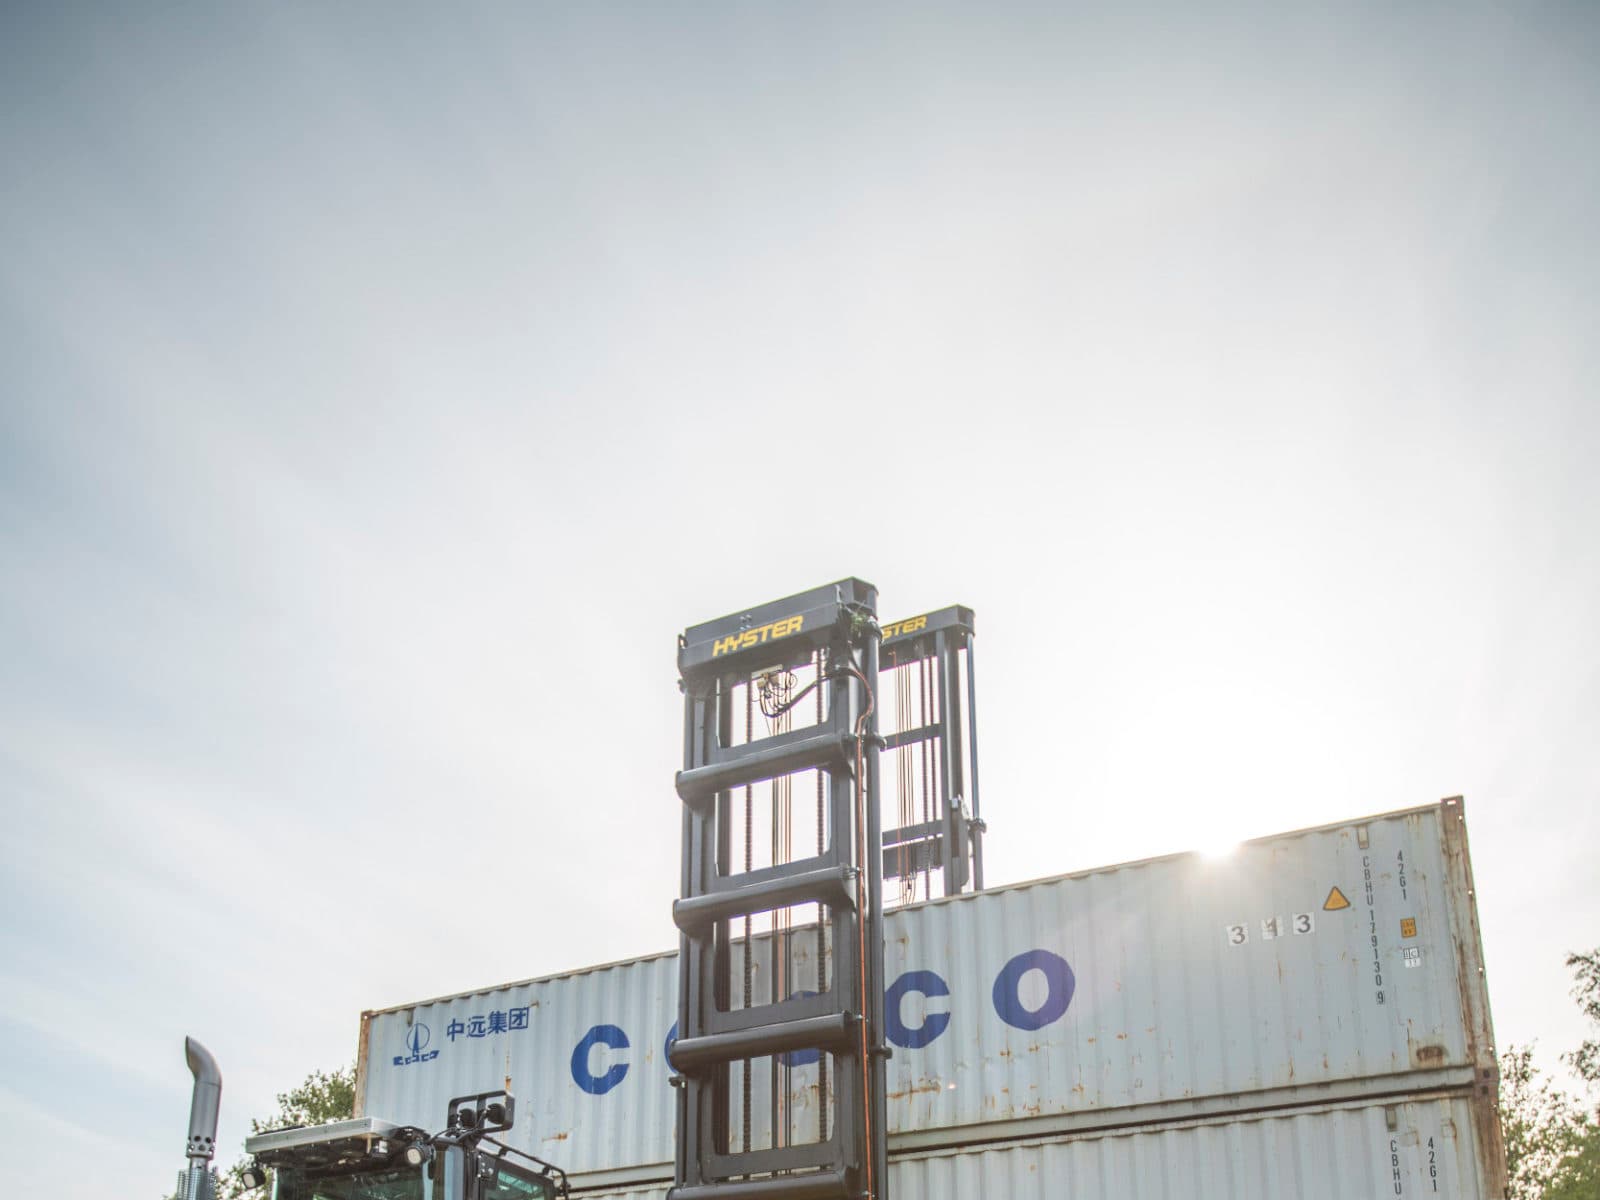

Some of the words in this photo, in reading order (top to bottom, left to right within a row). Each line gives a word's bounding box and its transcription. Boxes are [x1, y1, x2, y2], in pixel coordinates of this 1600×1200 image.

[712, 615, 804, 657] HYSTER
[883, 615, 927, 639] STER
[1397, 850, 1407, 901] 42G1
[1362, 856, 1374, 906] CBHU
[1369, 909, 1382, 987] 179130
[446, 1007, 530, 1042] 中远集团
[1390, 1139, 1402, 1195] CBHU
[1427, 1136, 1438, 1193] 42G1
